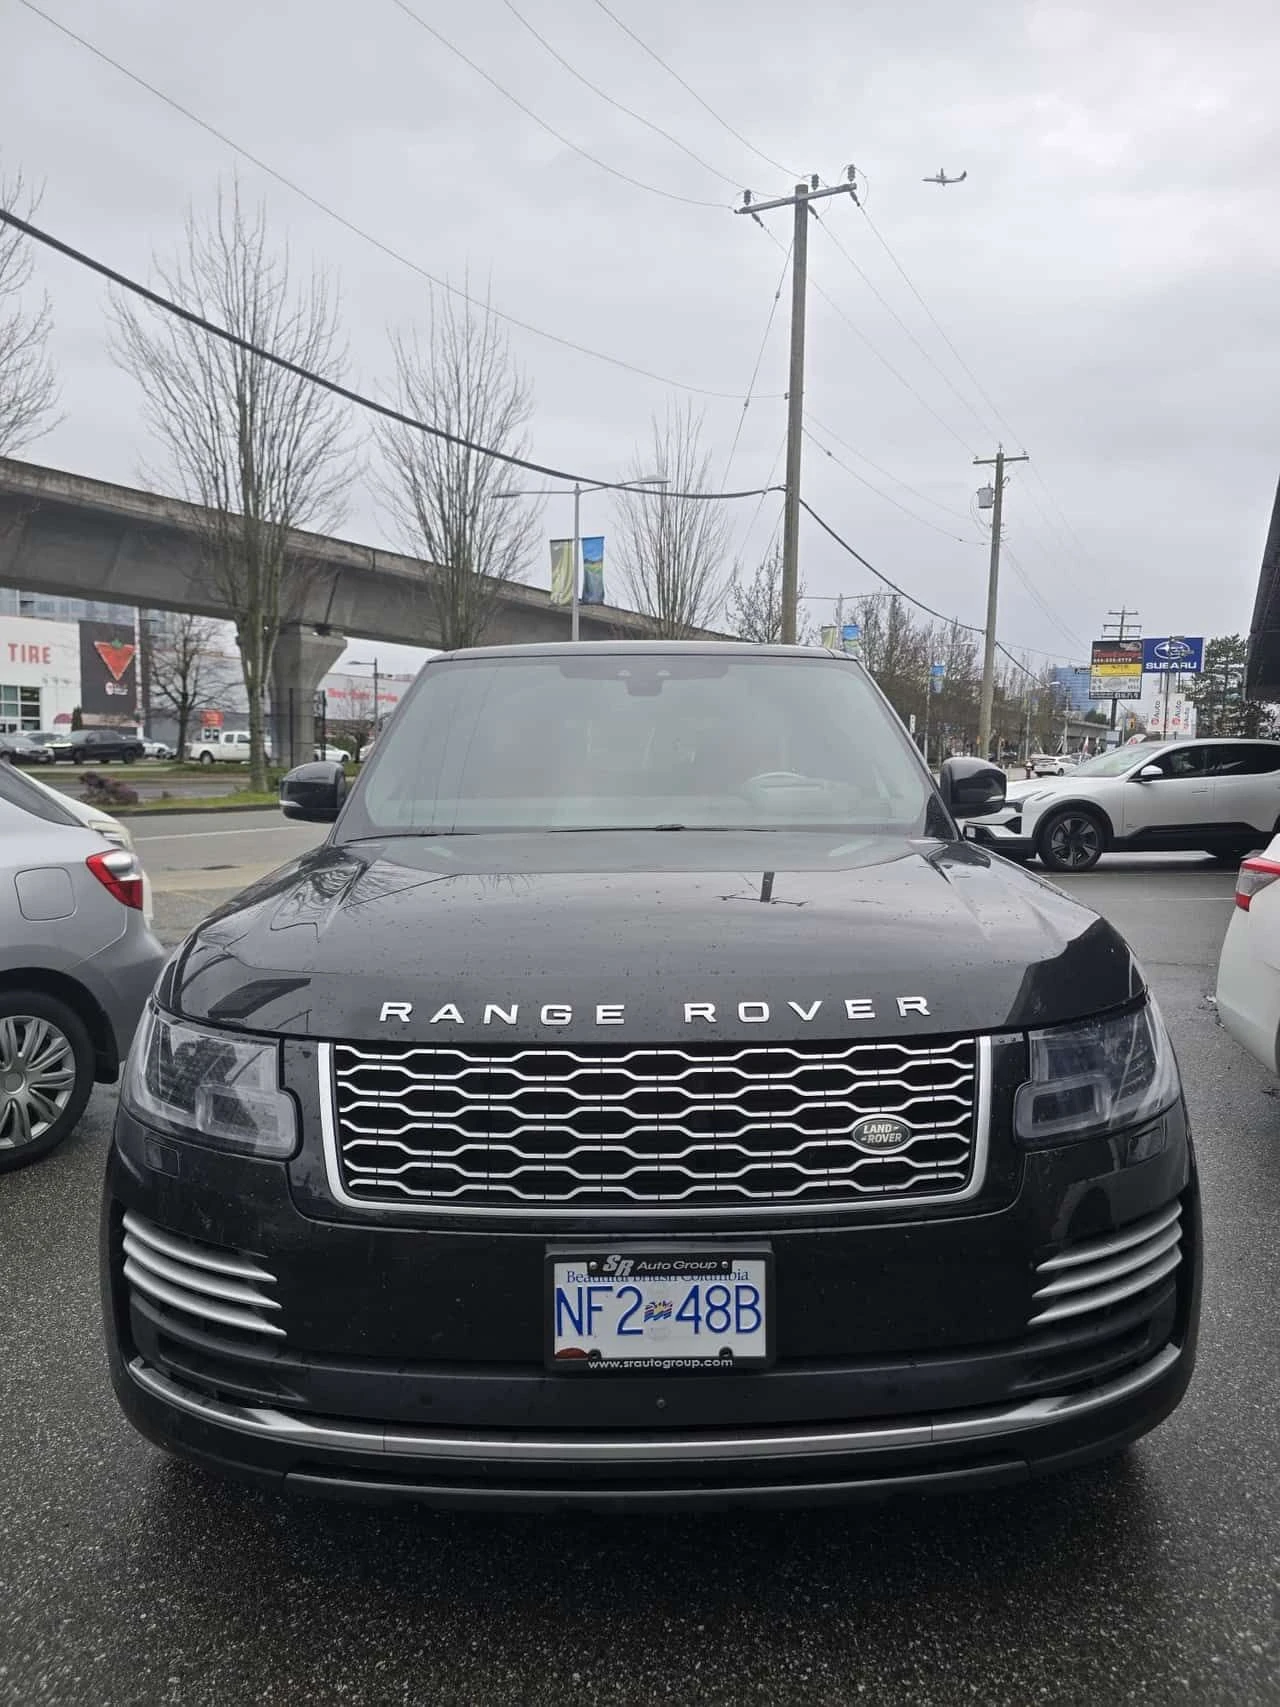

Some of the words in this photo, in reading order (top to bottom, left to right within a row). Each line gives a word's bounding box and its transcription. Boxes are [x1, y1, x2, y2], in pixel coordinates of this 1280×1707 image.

[8, 643, 51, 664] TIRE
[1145, 661, 1197, 670] SUBARU
[379, 1001, 625, 1025] RANGE
[683, 996, 931, 1023] ROVER
[863, 1123, 892, 1134] LAND
[867, 1132, 902, 1143] ROVER
[602, 1254, 635, 1276] SR
[637, 1261, 671, 1271] Auto
[673, 1260, 717, 1270] Group
[556, 1286, 643, 1337] NF2
[675, 1284, 762, 1335] 48B
[588, 1358, 733, 1369] www.srautogroup.com
